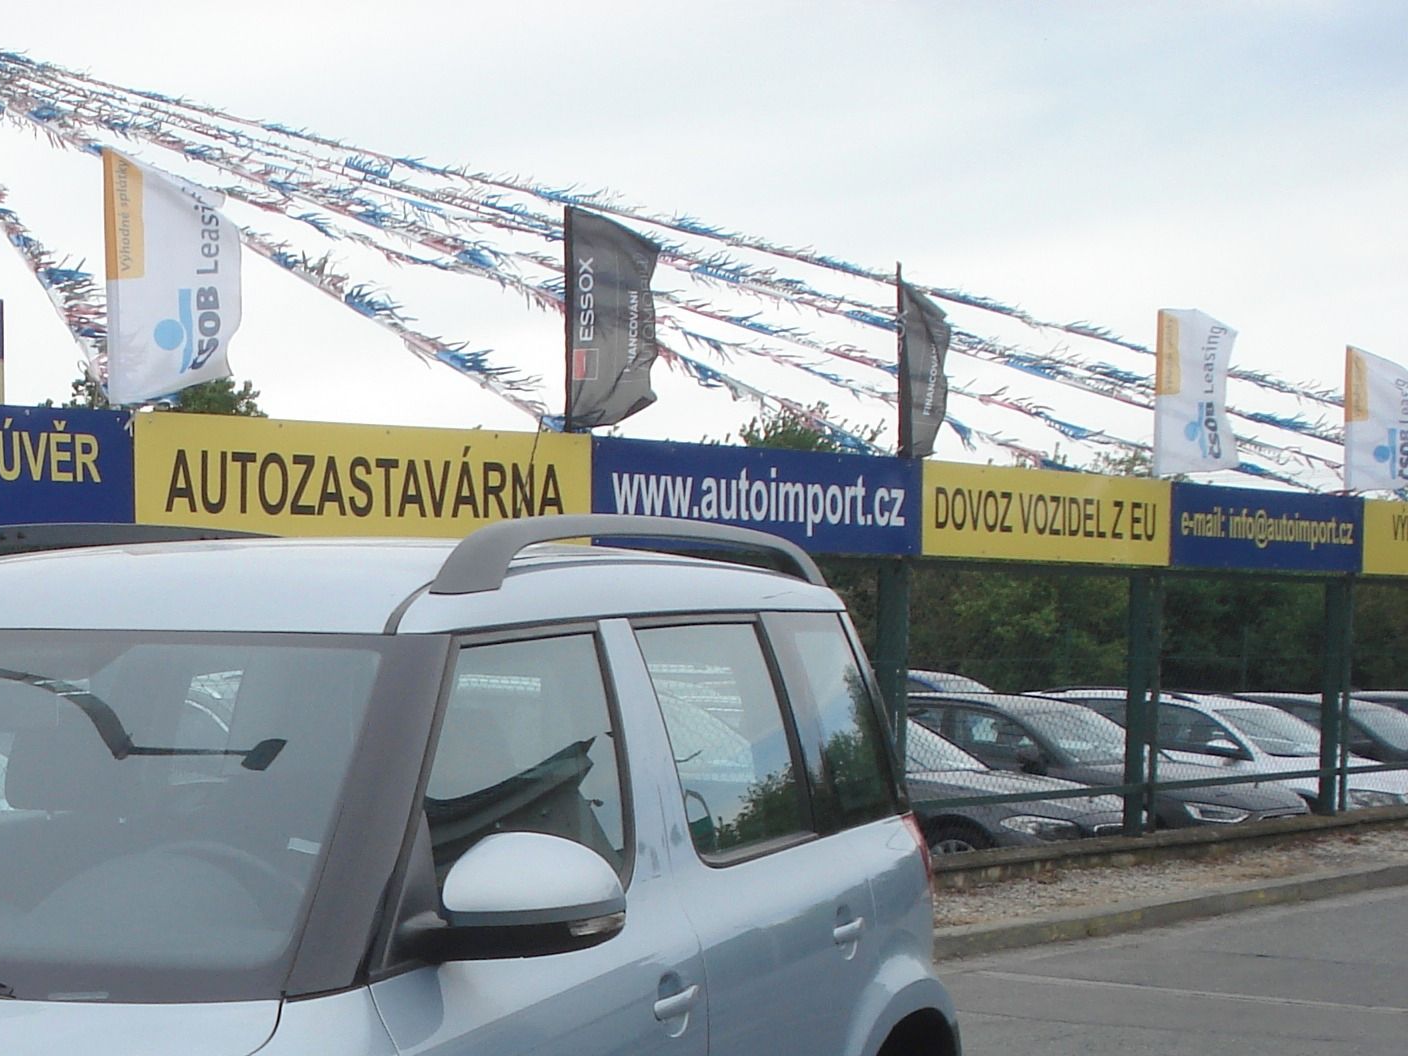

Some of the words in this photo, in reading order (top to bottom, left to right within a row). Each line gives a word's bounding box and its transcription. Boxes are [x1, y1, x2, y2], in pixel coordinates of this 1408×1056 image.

[193, 195, 220, 275] Leasi
[579, 257, 595, 342] ESSOX
[1202, 325, 1228, 394] Leasing
[165, 446, 566, 519] AUTOZASTAVÁRNA
[612, 467, 905, 537] www.autoimport.cz
[935, 486, 1012, 532] DOVOZ
[1019, 493, 1106, 539] VOZIDEL
[1111, 501, 1125, 540] Z
[1130, 502, 1156, 541] EU
[1181, 506, 1225, 538] e-mail:
[1229, 508, 1354, 549] info@autoimport.cz
